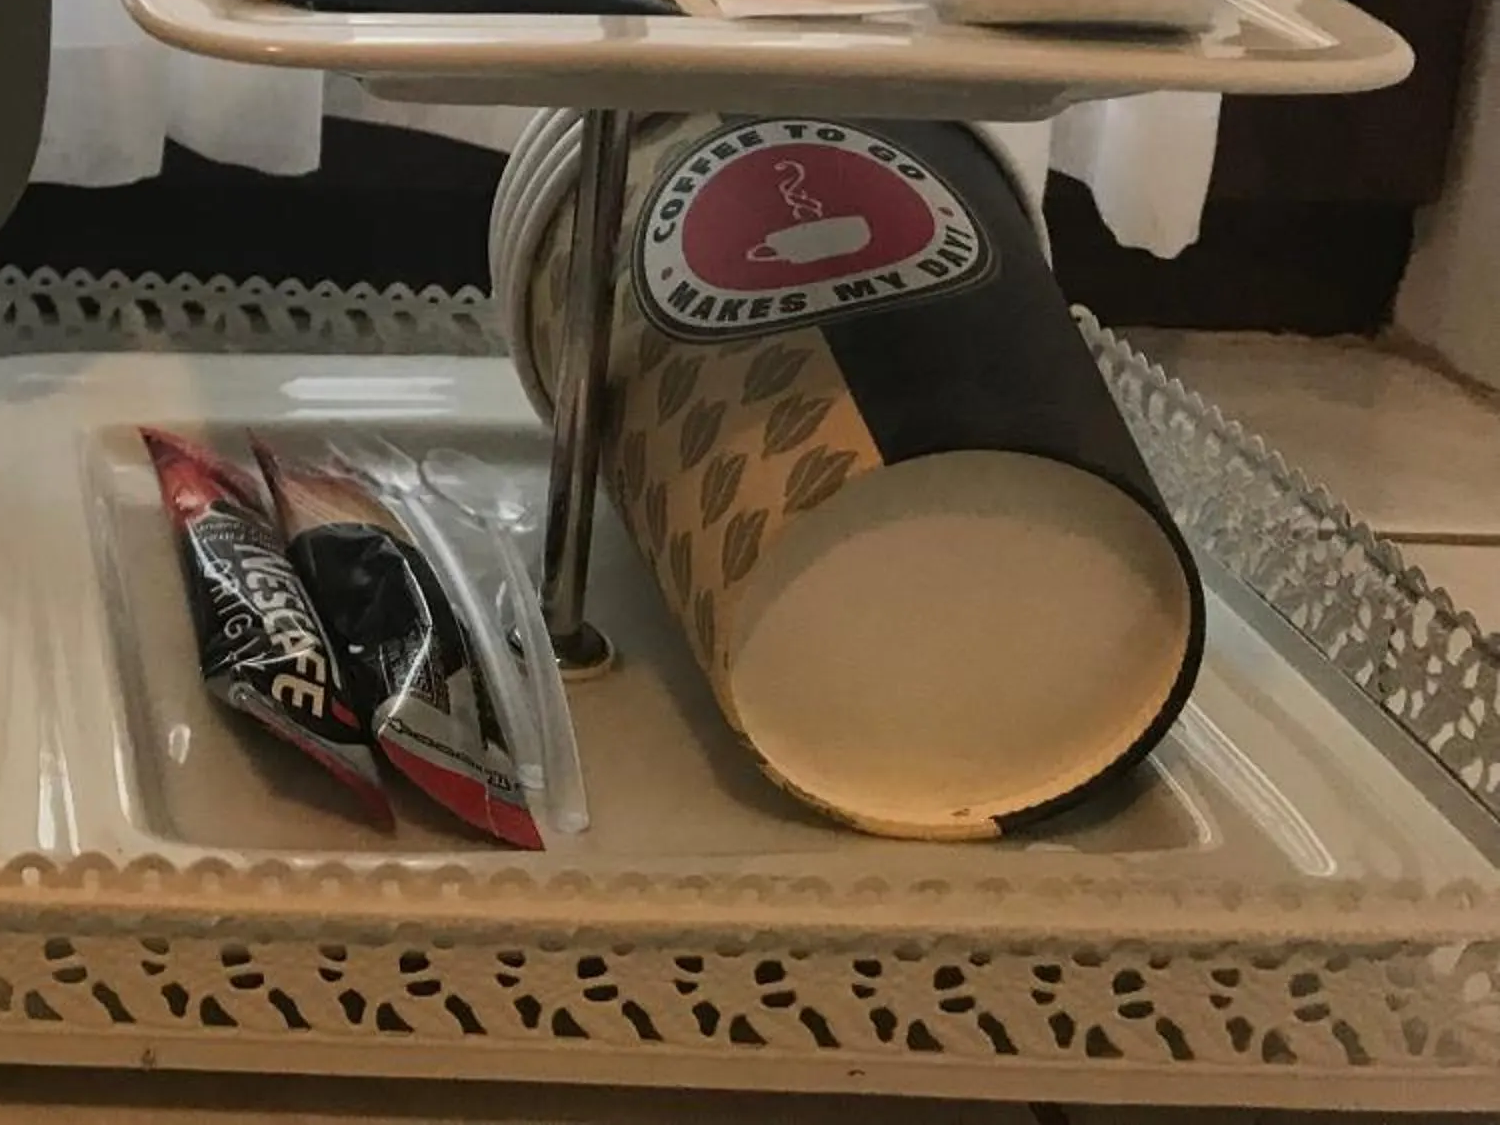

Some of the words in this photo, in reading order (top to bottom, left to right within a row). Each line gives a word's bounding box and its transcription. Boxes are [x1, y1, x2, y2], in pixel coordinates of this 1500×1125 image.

[652, 130, 764, 244] COFFEE
[783, 124, 846, 142] TO
[867, 144, 927, 181] GO
[666, 280, 808, 322] MAKES
[833, 271, 908, 303] MY
[916, 225, 974, 278] DAY!
